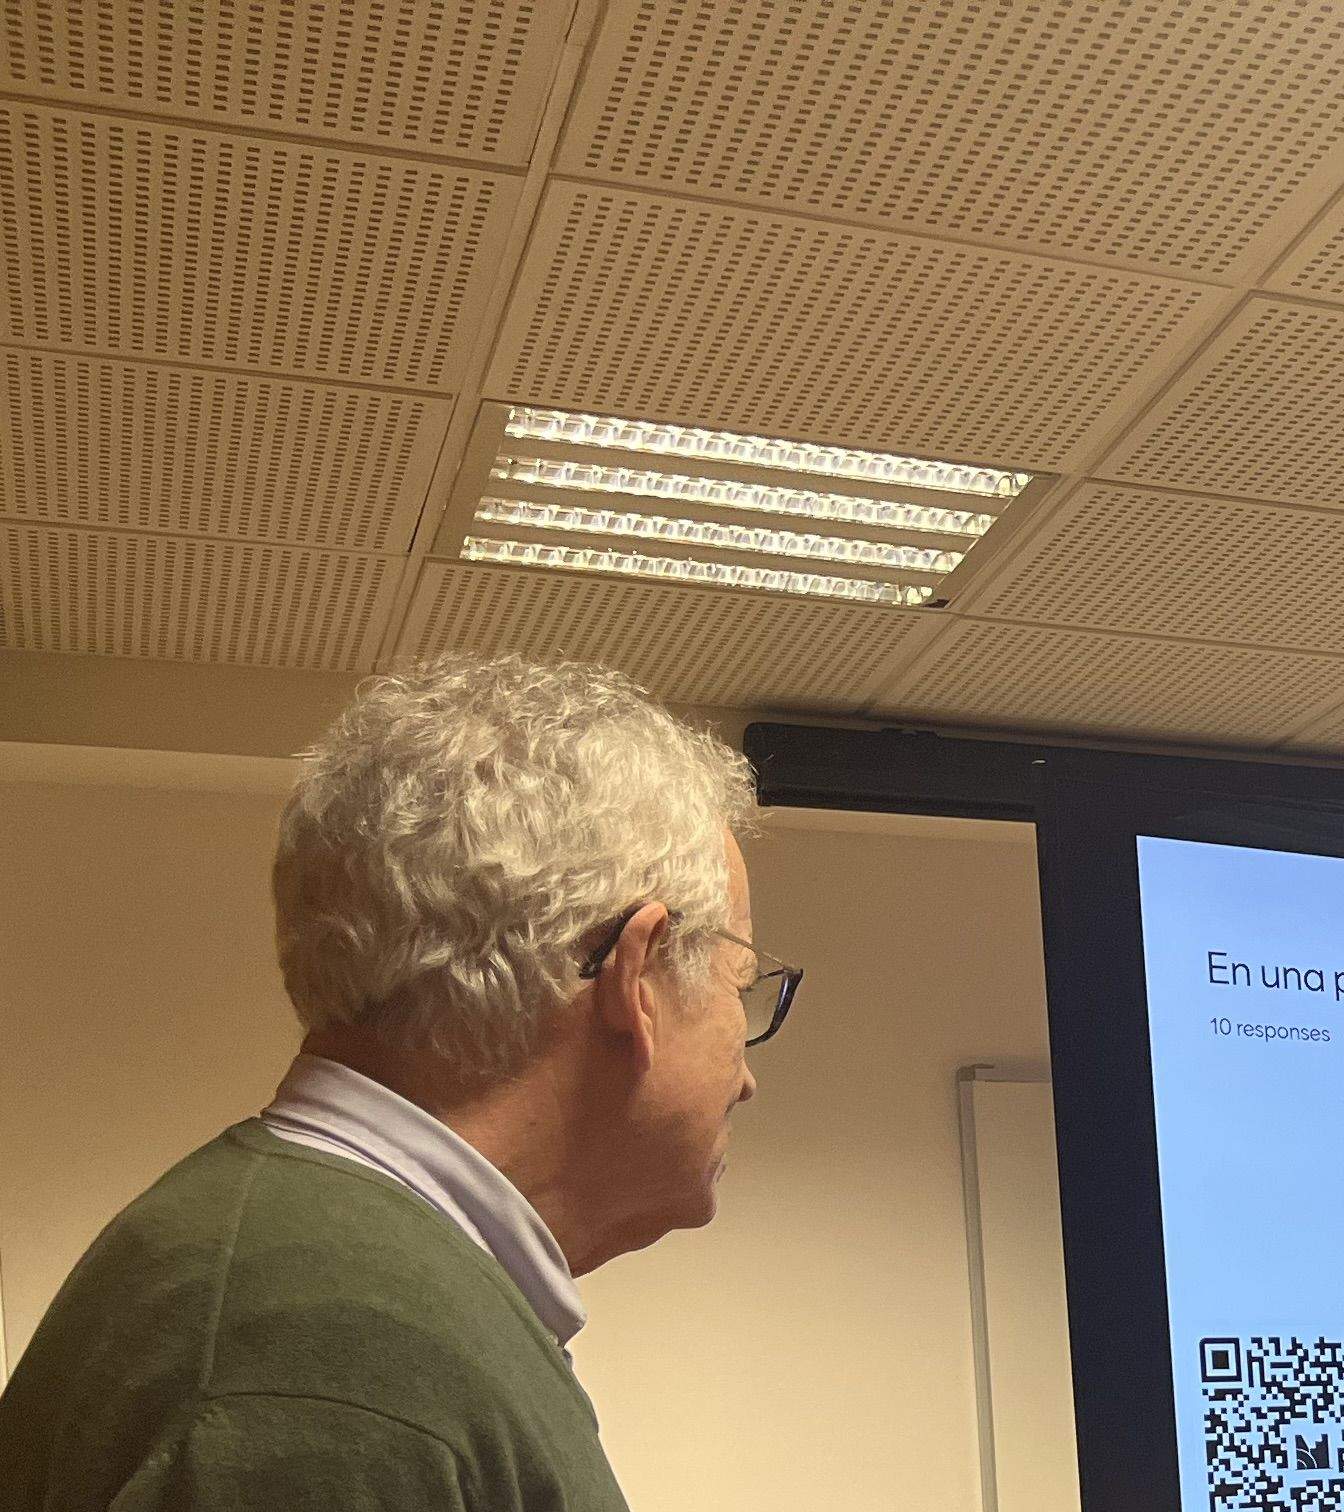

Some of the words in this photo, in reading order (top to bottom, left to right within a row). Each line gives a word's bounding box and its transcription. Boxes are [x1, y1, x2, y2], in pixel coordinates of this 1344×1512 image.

[1208, 952, 1250, 986] En
[1262, 966, 1324, 991] una
[1211, 1017, 1231, 1035] 10
[1237, 1024, 1330, 1042] responses
